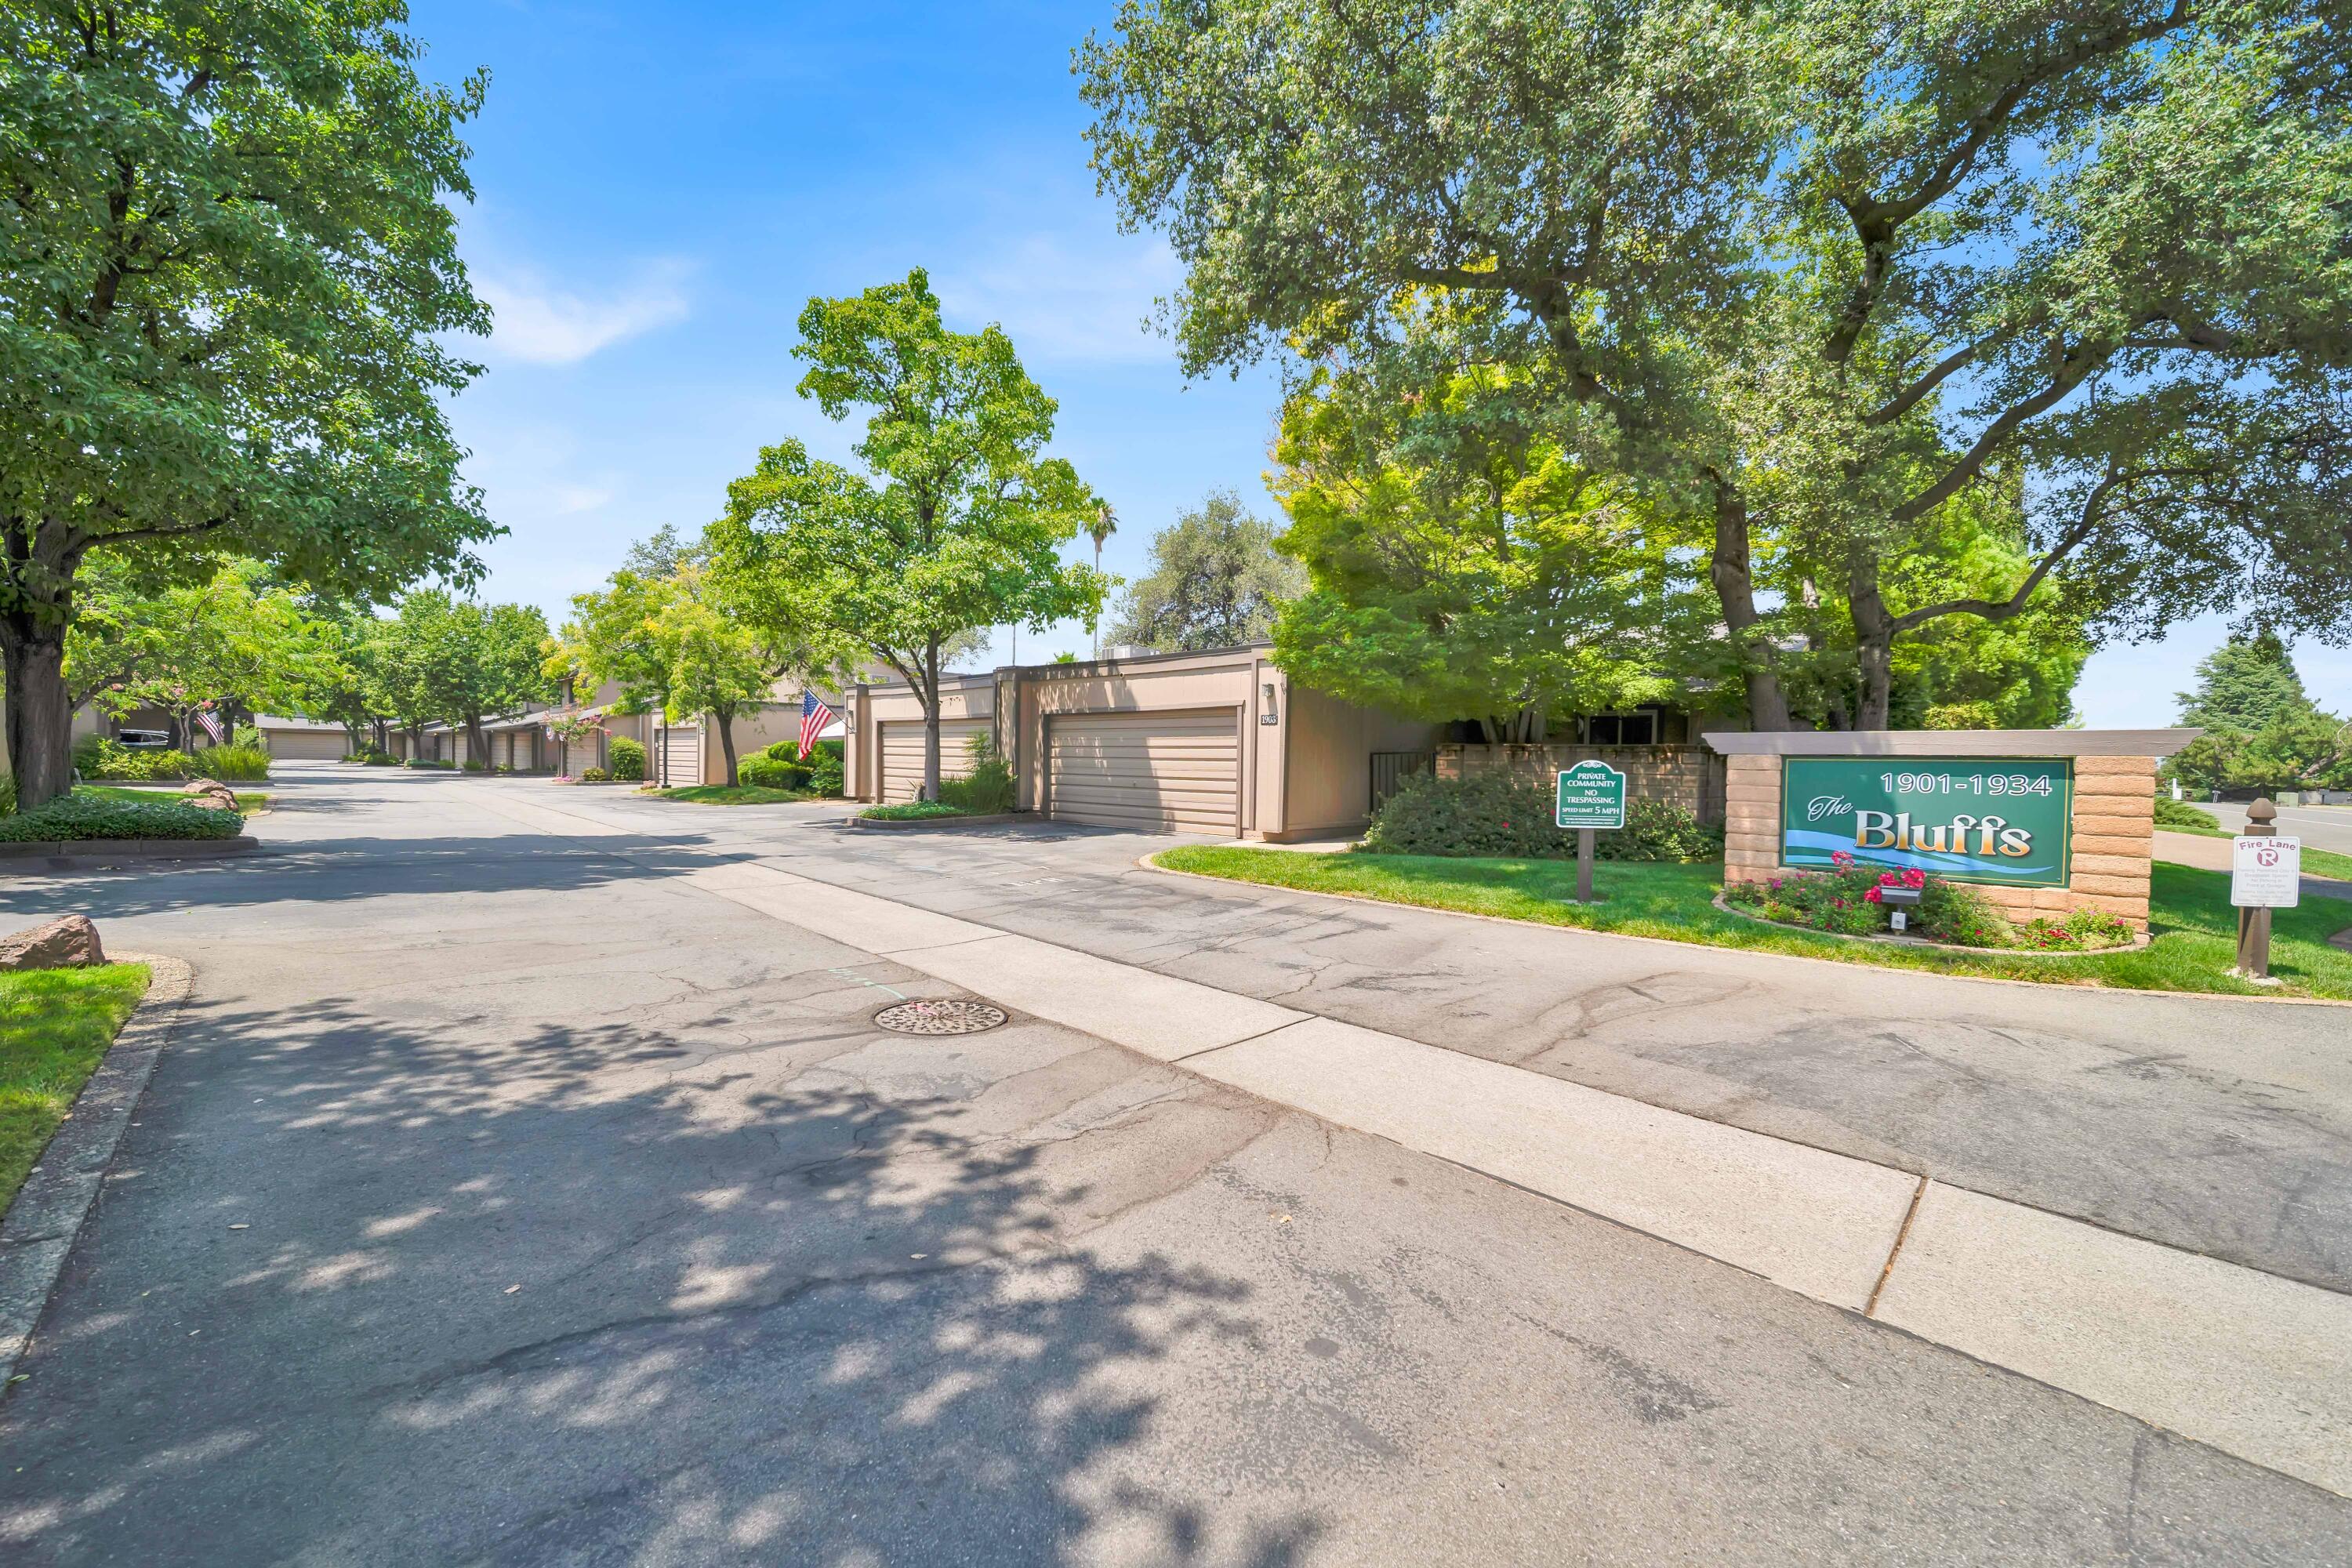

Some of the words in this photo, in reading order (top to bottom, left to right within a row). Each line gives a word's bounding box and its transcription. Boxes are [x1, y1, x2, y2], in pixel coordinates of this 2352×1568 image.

[1880, 772, 2053, 797] 1901-1934
[1806, 794, 1855, 822] The
[1853, 810, 2033, 858] Bluffs
[2239, 841, 2263, 850] Fire
[2269, 840, 2296, 851] Lane
